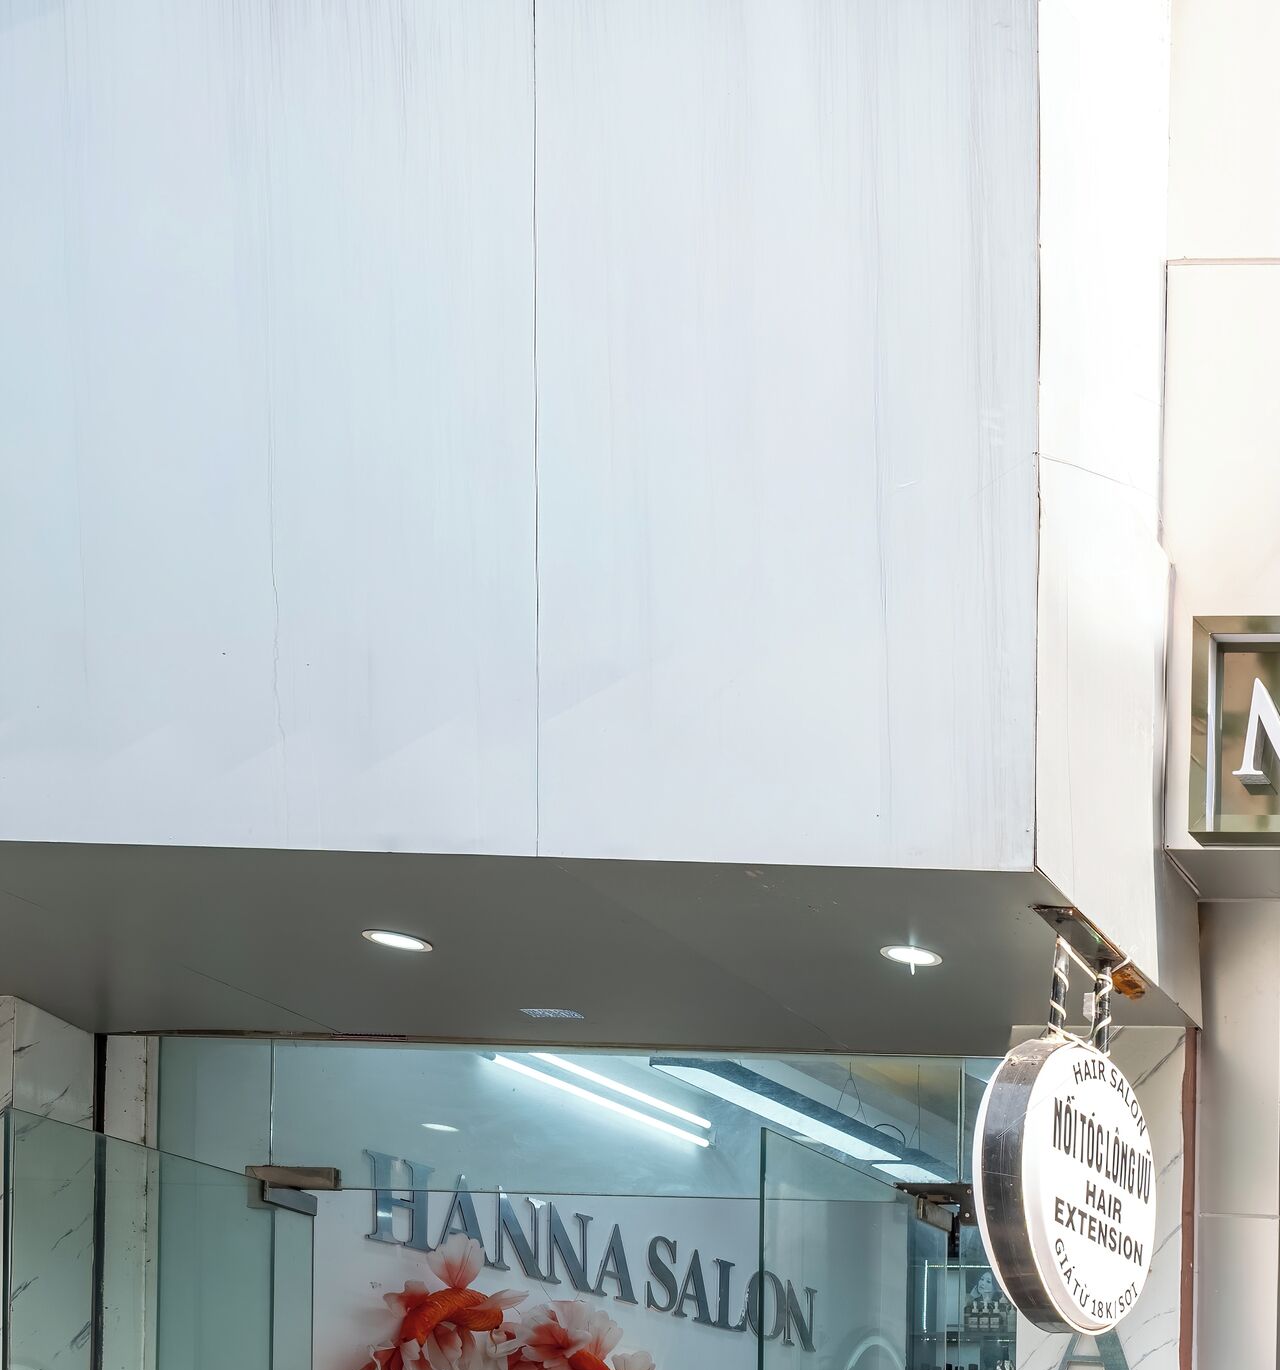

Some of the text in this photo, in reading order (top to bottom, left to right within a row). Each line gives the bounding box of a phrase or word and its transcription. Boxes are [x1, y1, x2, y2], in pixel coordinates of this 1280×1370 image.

[1073, 1060, 1147, 1137] HAIR SALON
[1080, 1112, 1104, 1174] TÓC
[1105, 1127, 1136, 1194] LÔNG
[1137, 1149, 1152, 1205] VŨ
[1054, 1196, 1144, 1266] EXTENSION
[1085, 1180, 1122, 1224] HAIR
[363, 1149, 818, 1353] HANNA SALON
[1055, 1238, 1077, 1285] GIÁ
